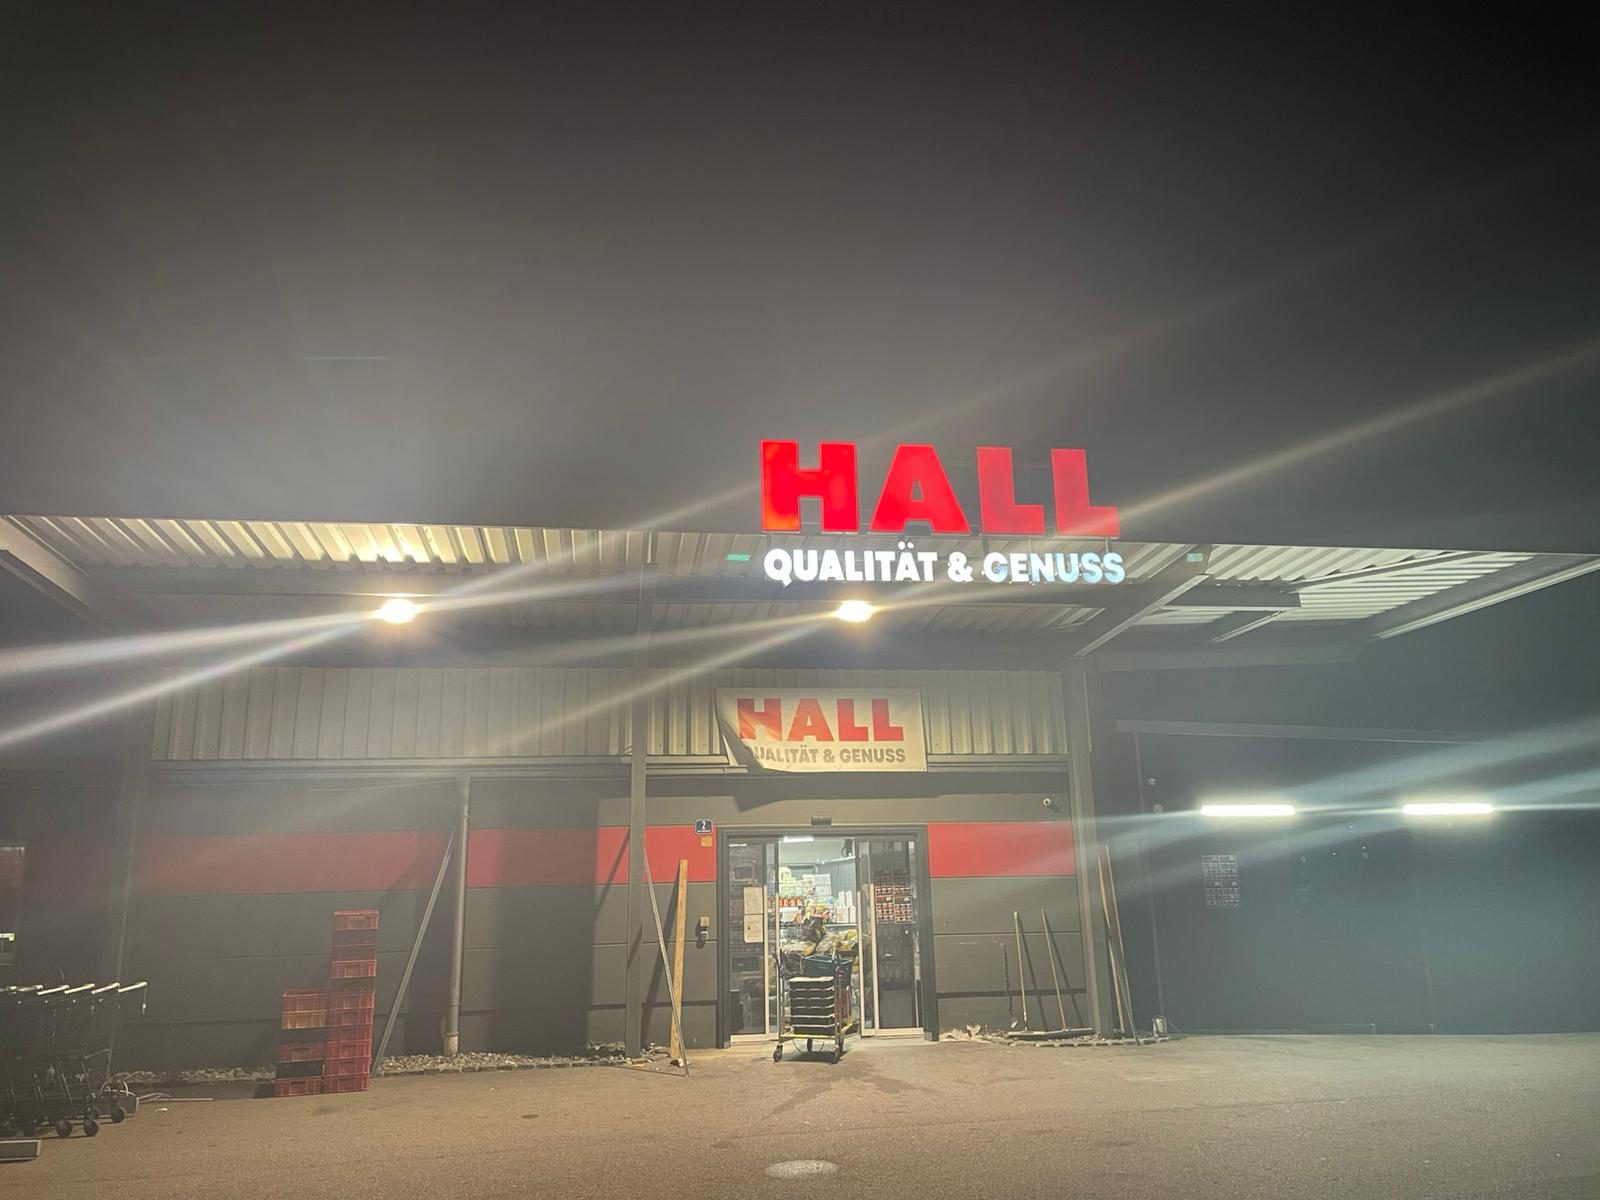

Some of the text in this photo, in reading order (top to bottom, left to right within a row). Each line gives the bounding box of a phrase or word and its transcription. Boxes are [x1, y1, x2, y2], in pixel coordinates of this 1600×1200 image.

[760, 439, 1121, 537] HALL
[764, 541, 1126, 588] QUALITÄT & GENUSS
[736, 698, 905, 742] HALL
[823, 749, 836, 763] &
[839, 748, 906, 764] GENUSS
